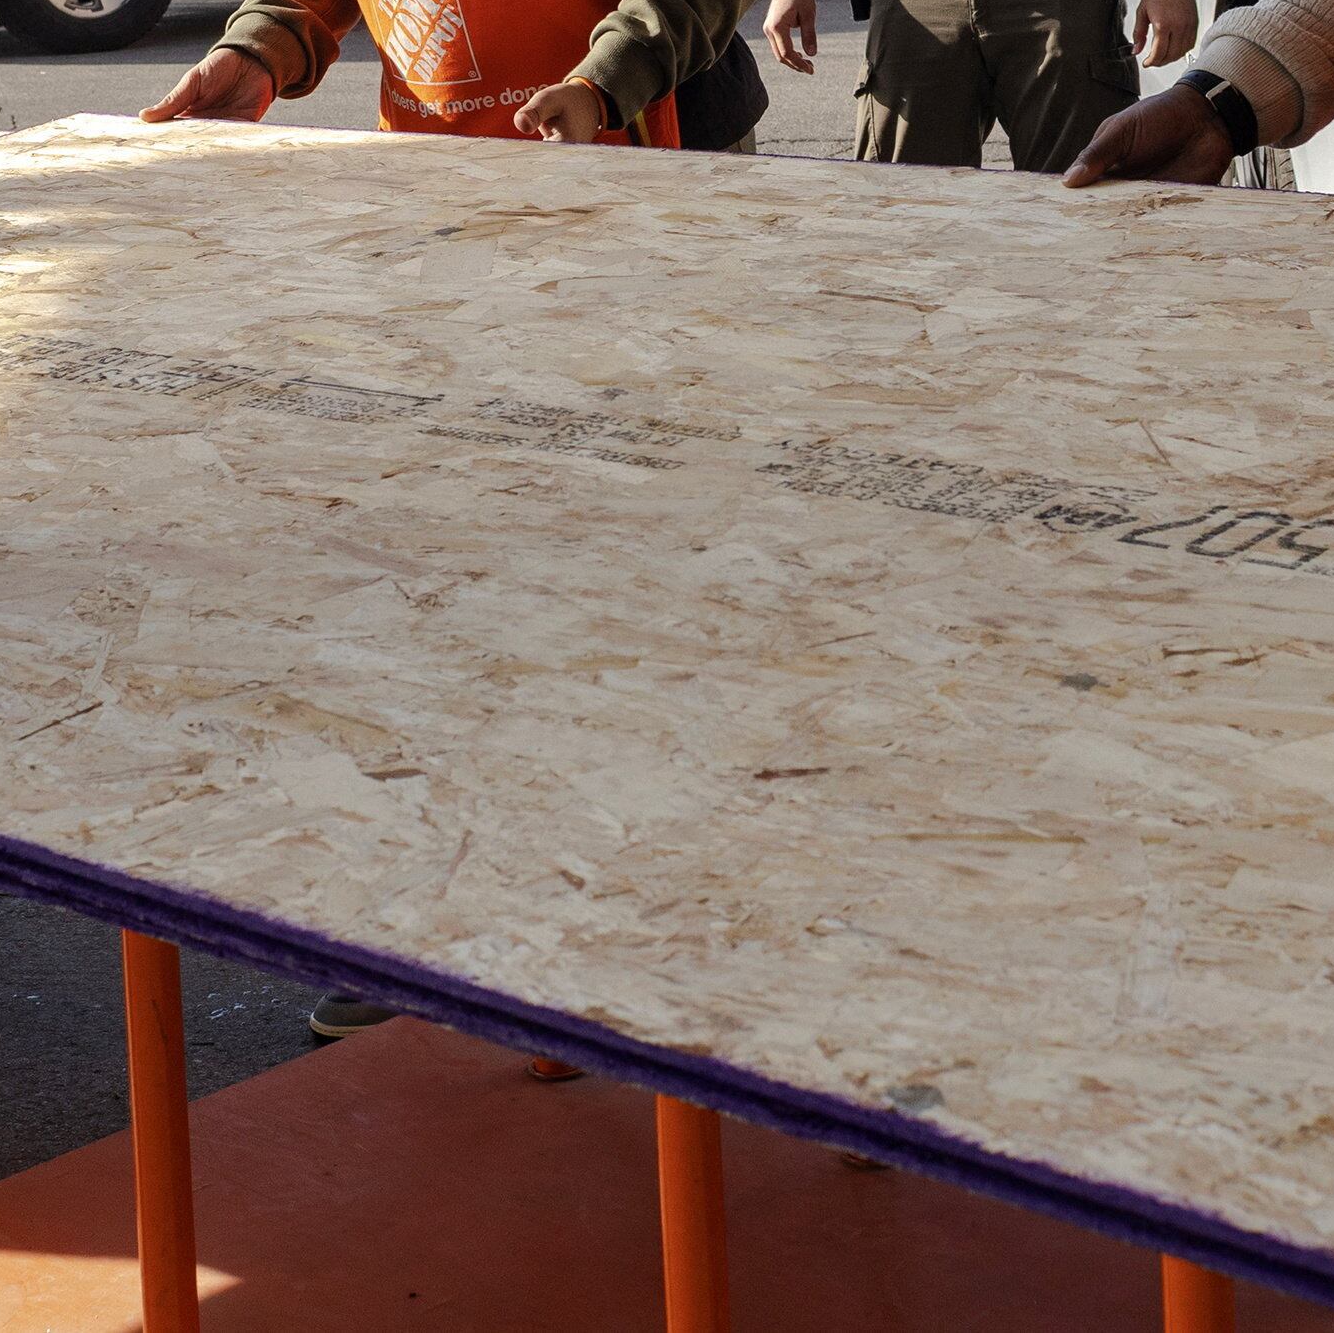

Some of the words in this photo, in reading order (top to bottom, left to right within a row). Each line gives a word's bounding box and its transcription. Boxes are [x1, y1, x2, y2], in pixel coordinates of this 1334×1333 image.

[413, 2, 464, 83] DEPOT
[419, 99, 442, 119] get
[446, 94, 496, 114] more
